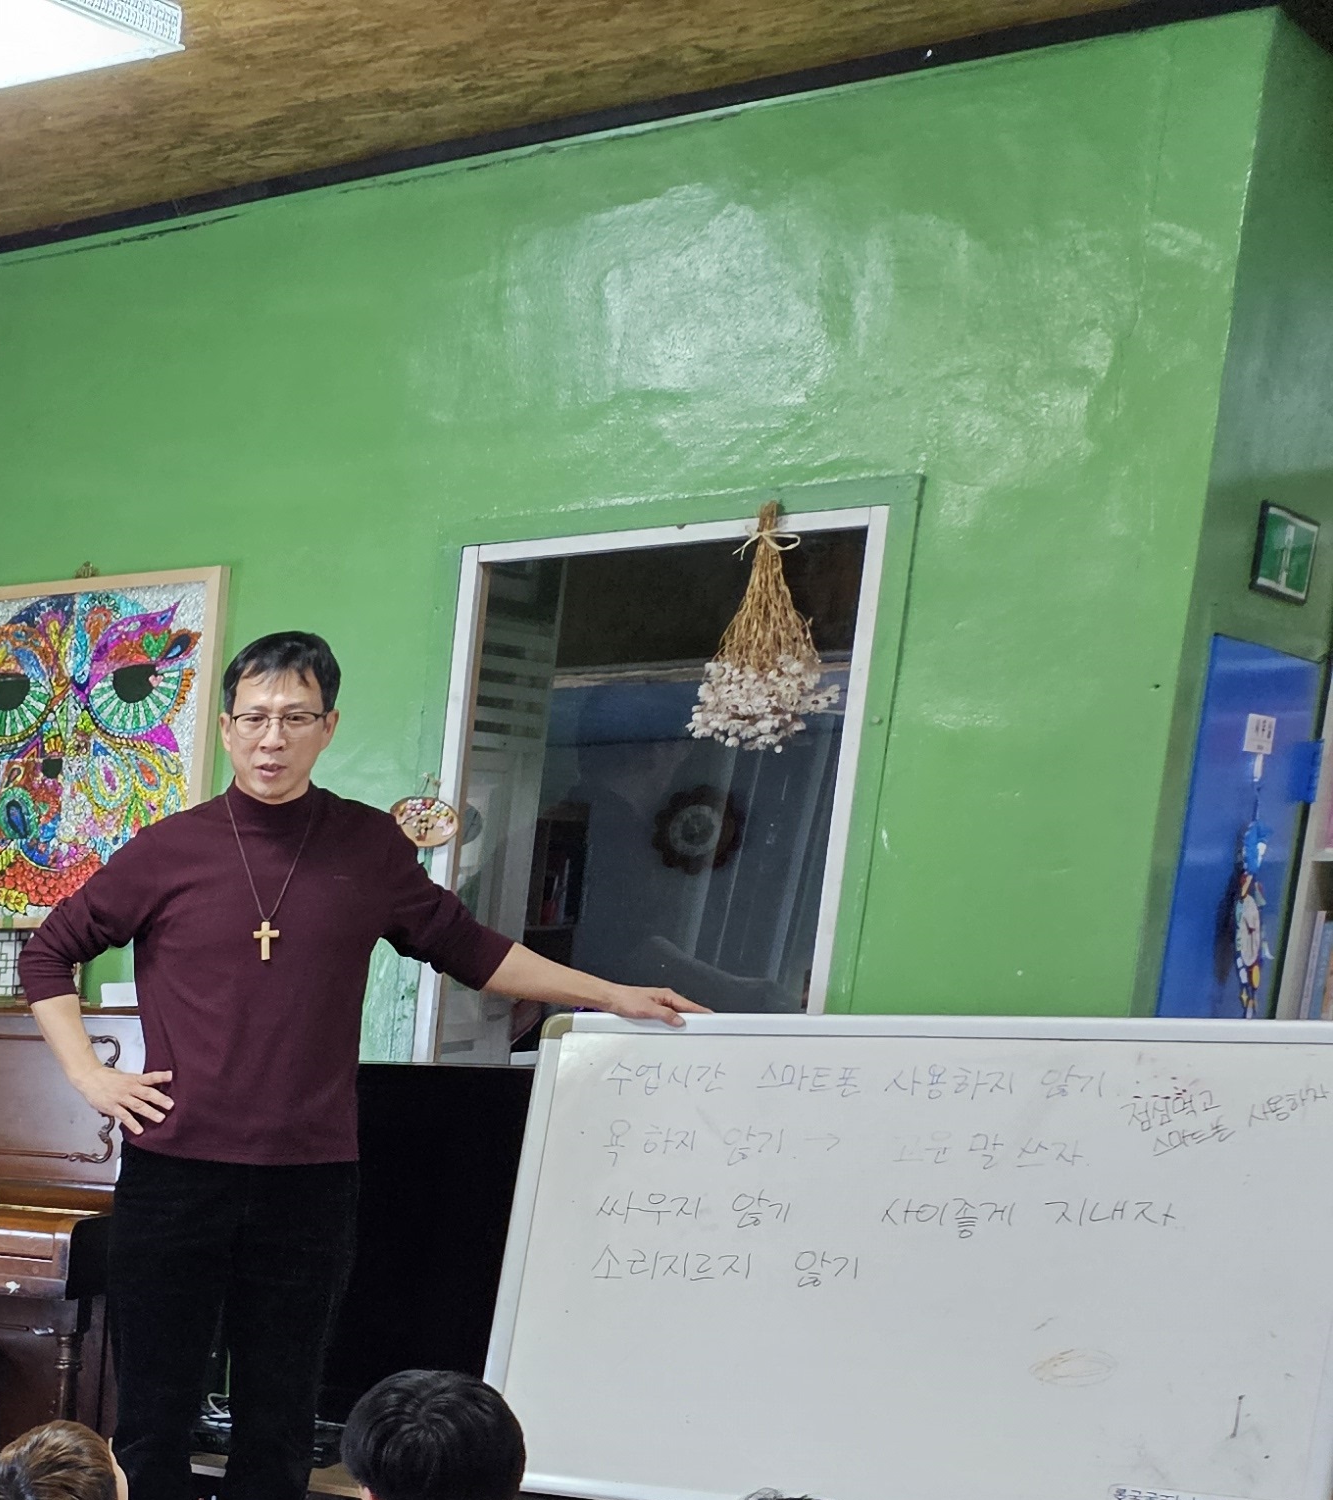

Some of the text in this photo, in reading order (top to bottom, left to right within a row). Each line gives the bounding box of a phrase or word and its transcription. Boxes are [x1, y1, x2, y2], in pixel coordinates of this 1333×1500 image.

[607, 1062, 726, 1096] 수업시간
[756, 1062, 861, 1098] 스마트폰
[884, 1063, 1014, 1100] 사용하지
[1249, 1084, 1330, 1127] 사용하자
[603, 1119, 632, 1167] 욕
[644, 1124, 697, 1154] 하지
[968, 1133, 1004, 1170] 말
[596, 1189, 791, 1229] 싸우지 않기
[881, 1197, 1177, 1239] 사이좋게 지내자
[591, 1244, 859, 1288] 소리지르지 않기
